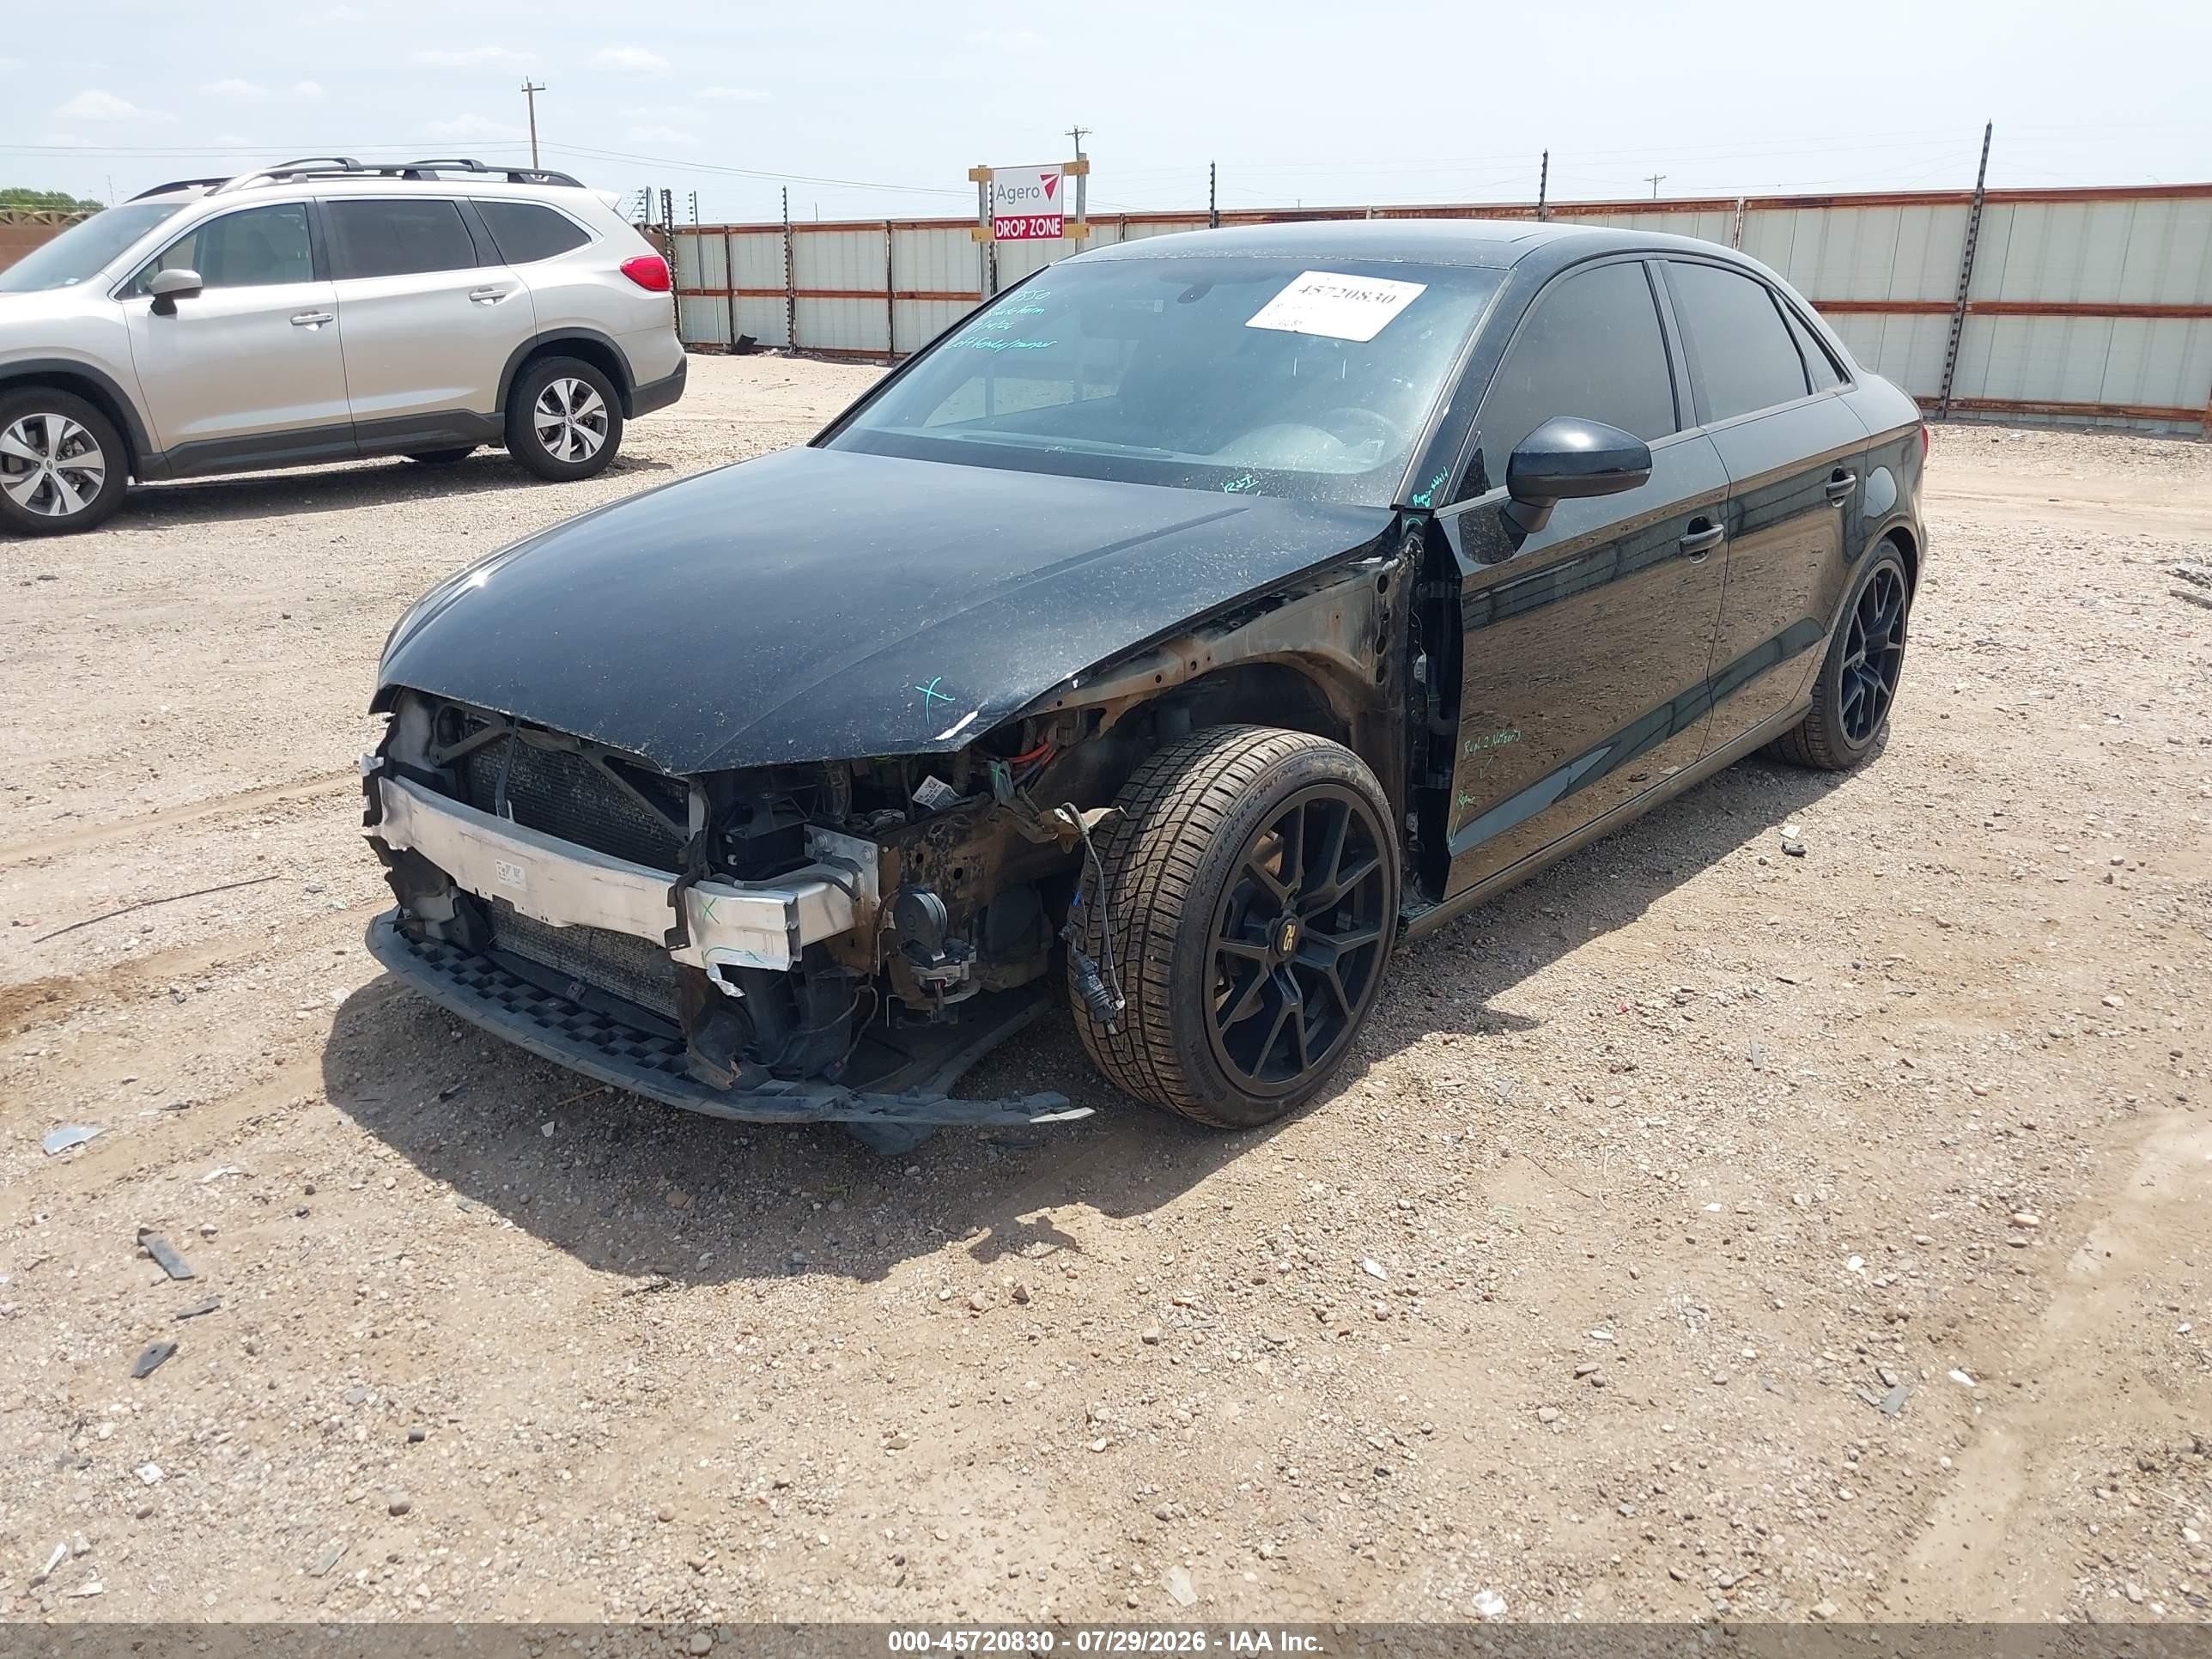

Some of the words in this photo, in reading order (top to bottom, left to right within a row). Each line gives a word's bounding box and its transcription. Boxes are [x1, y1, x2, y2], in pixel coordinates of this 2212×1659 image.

[996, 184, 1040, 204] Agero
[995, 220, 1027, 237] DROP
[1030, 217, 1060, 235] ZONE
